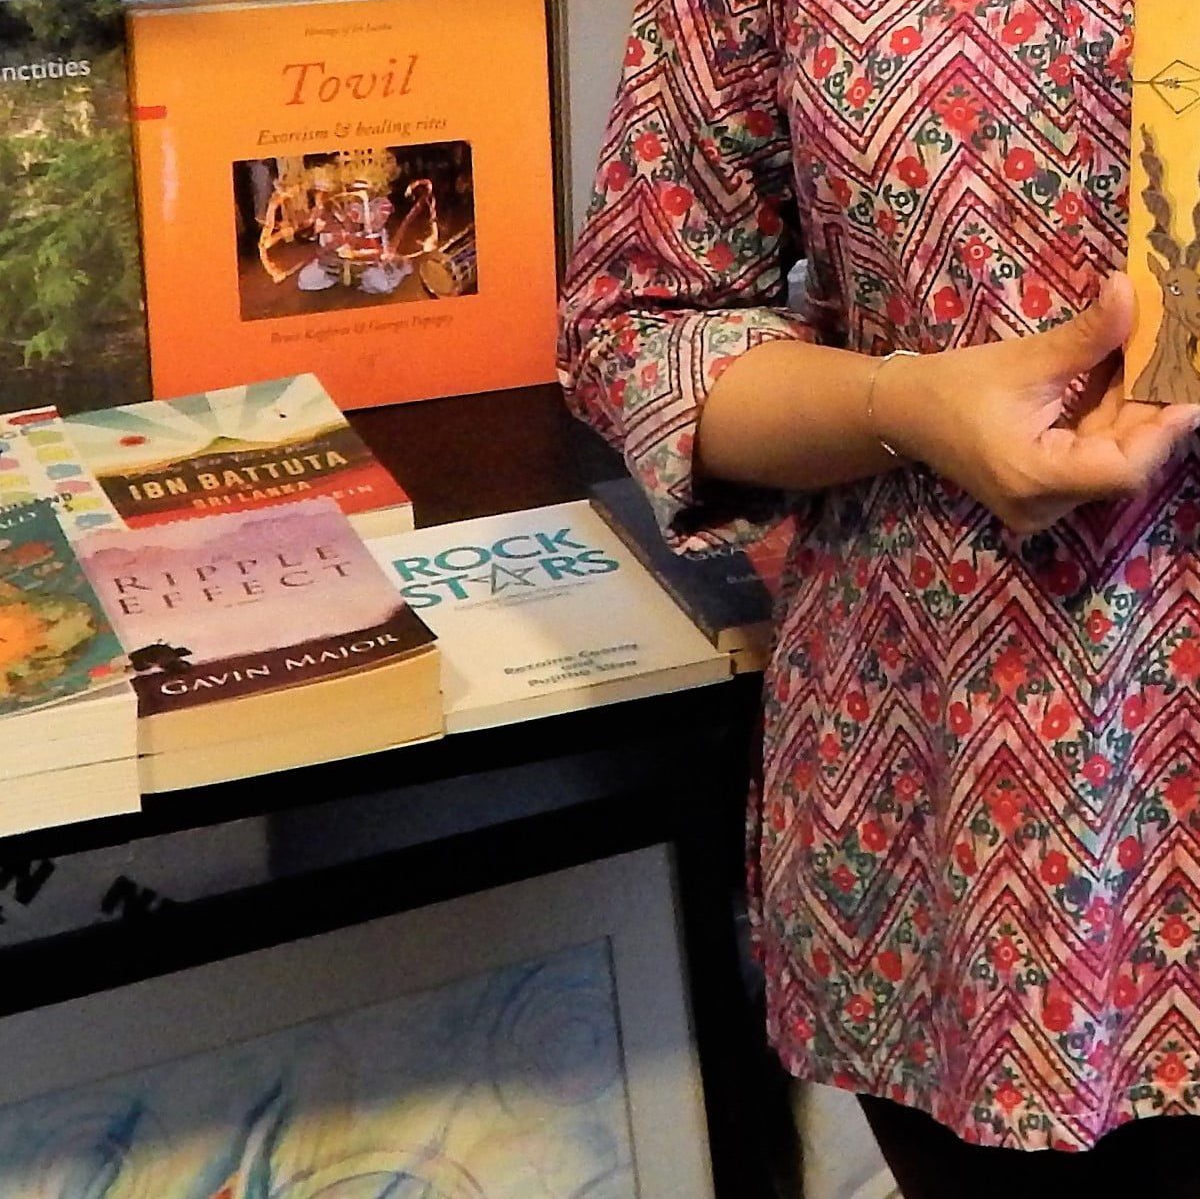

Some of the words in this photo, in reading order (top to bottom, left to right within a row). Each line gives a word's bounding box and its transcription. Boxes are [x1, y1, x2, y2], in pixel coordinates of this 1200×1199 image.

[282, 54, 418, 106] Tovil
[257, 128, 329, 145] Exorcism
[128, 476, 188, 501] IBN
[197, 451, 348, 491] BATTUTA
[192, 496, 232, 510] SRI
[237, 481, 312, 503] LANKA
[114, 546, 338, 594] RIPPLE
[391, 528, 587, 582] ROCK
[118, 561, 352, 615] EFFECT
[161, 665, 272, 696] GAVIN
